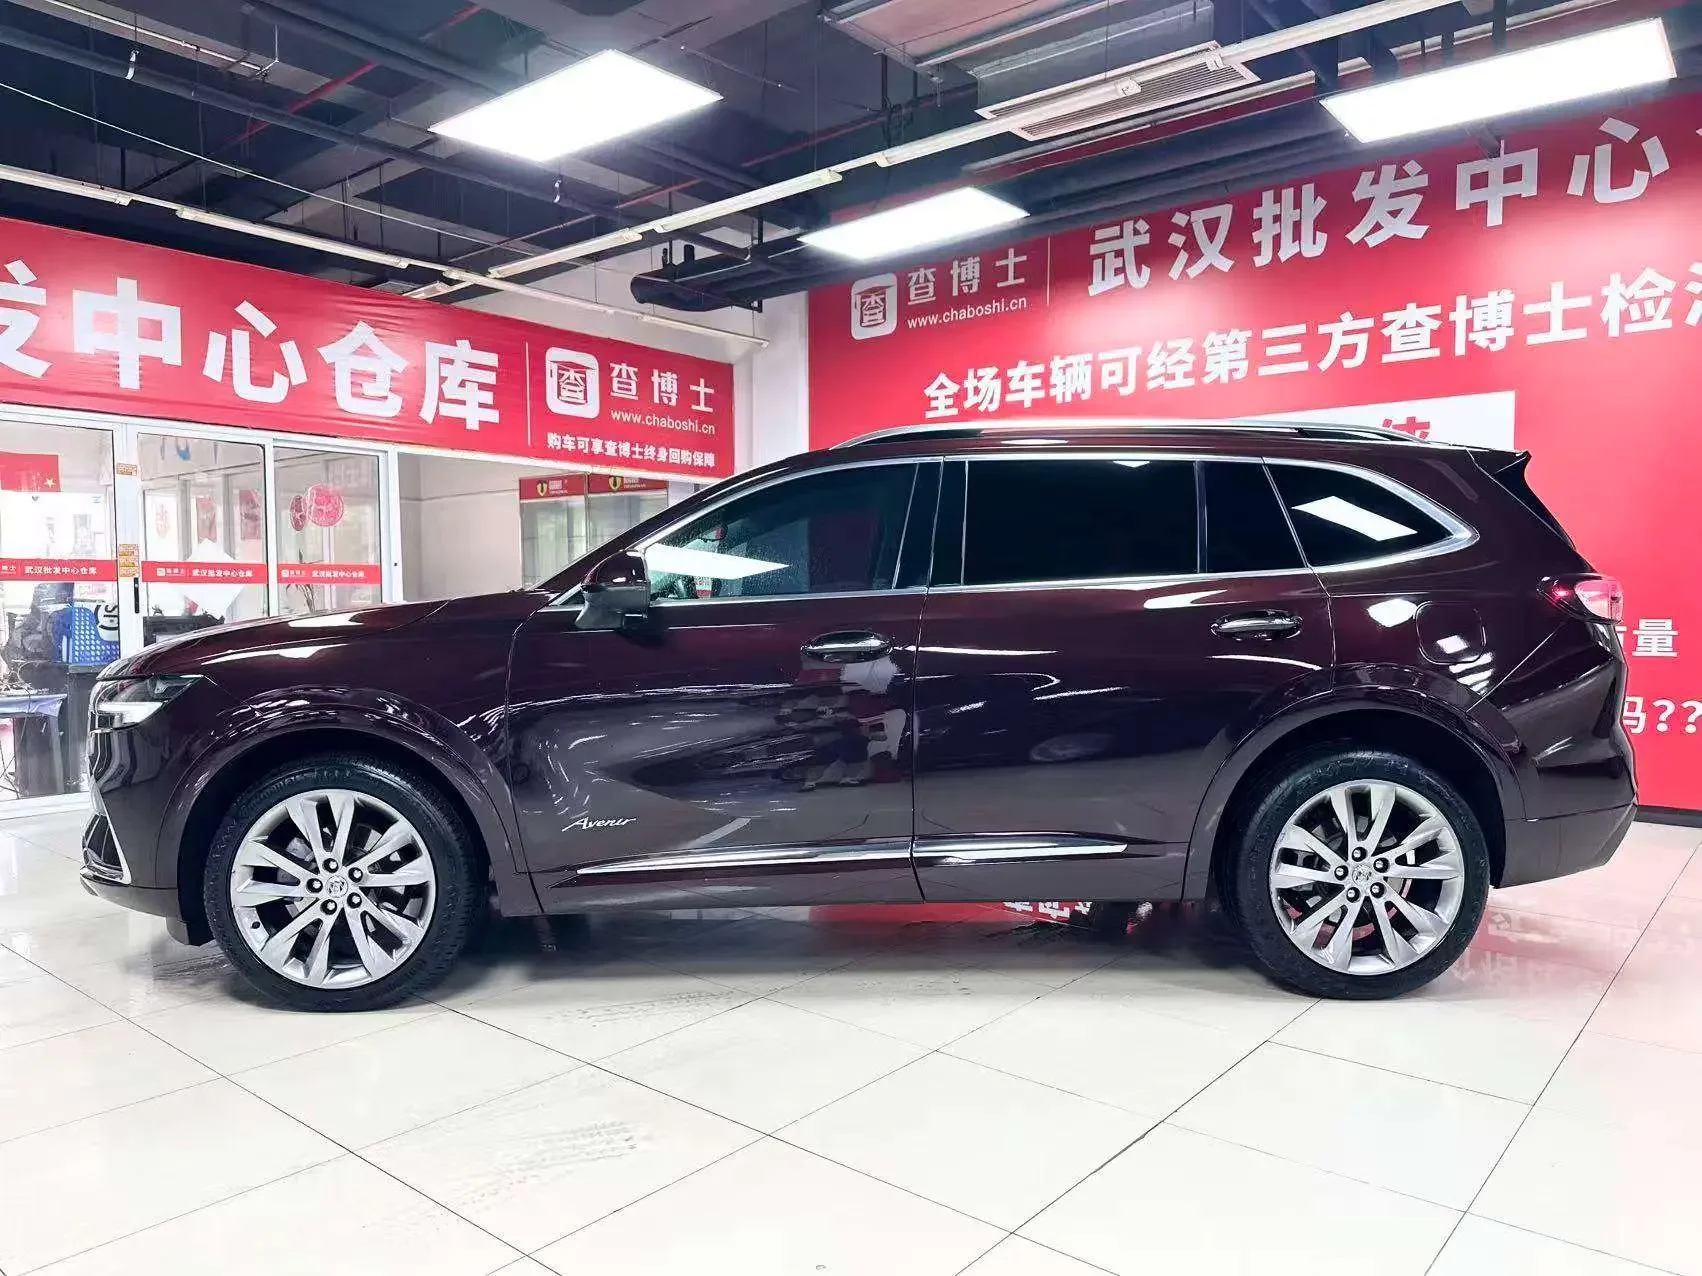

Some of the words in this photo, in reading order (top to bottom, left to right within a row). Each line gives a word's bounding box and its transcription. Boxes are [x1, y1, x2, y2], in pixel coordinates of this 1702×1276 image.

[1088, 117, 1702, 297] 武汉批发中心
[906, 248, 1028, 306] 查博士
[907, 297, 1028, 329] www.chaboshi.cn
[610, 362, 715, 413] 查博士
[611, 409, 716, 434] www.chaboshi.cn
[547, 432, 715, 467] 购车可享查博士终身回购保障
[561, 816, 637, 832] Avenir
